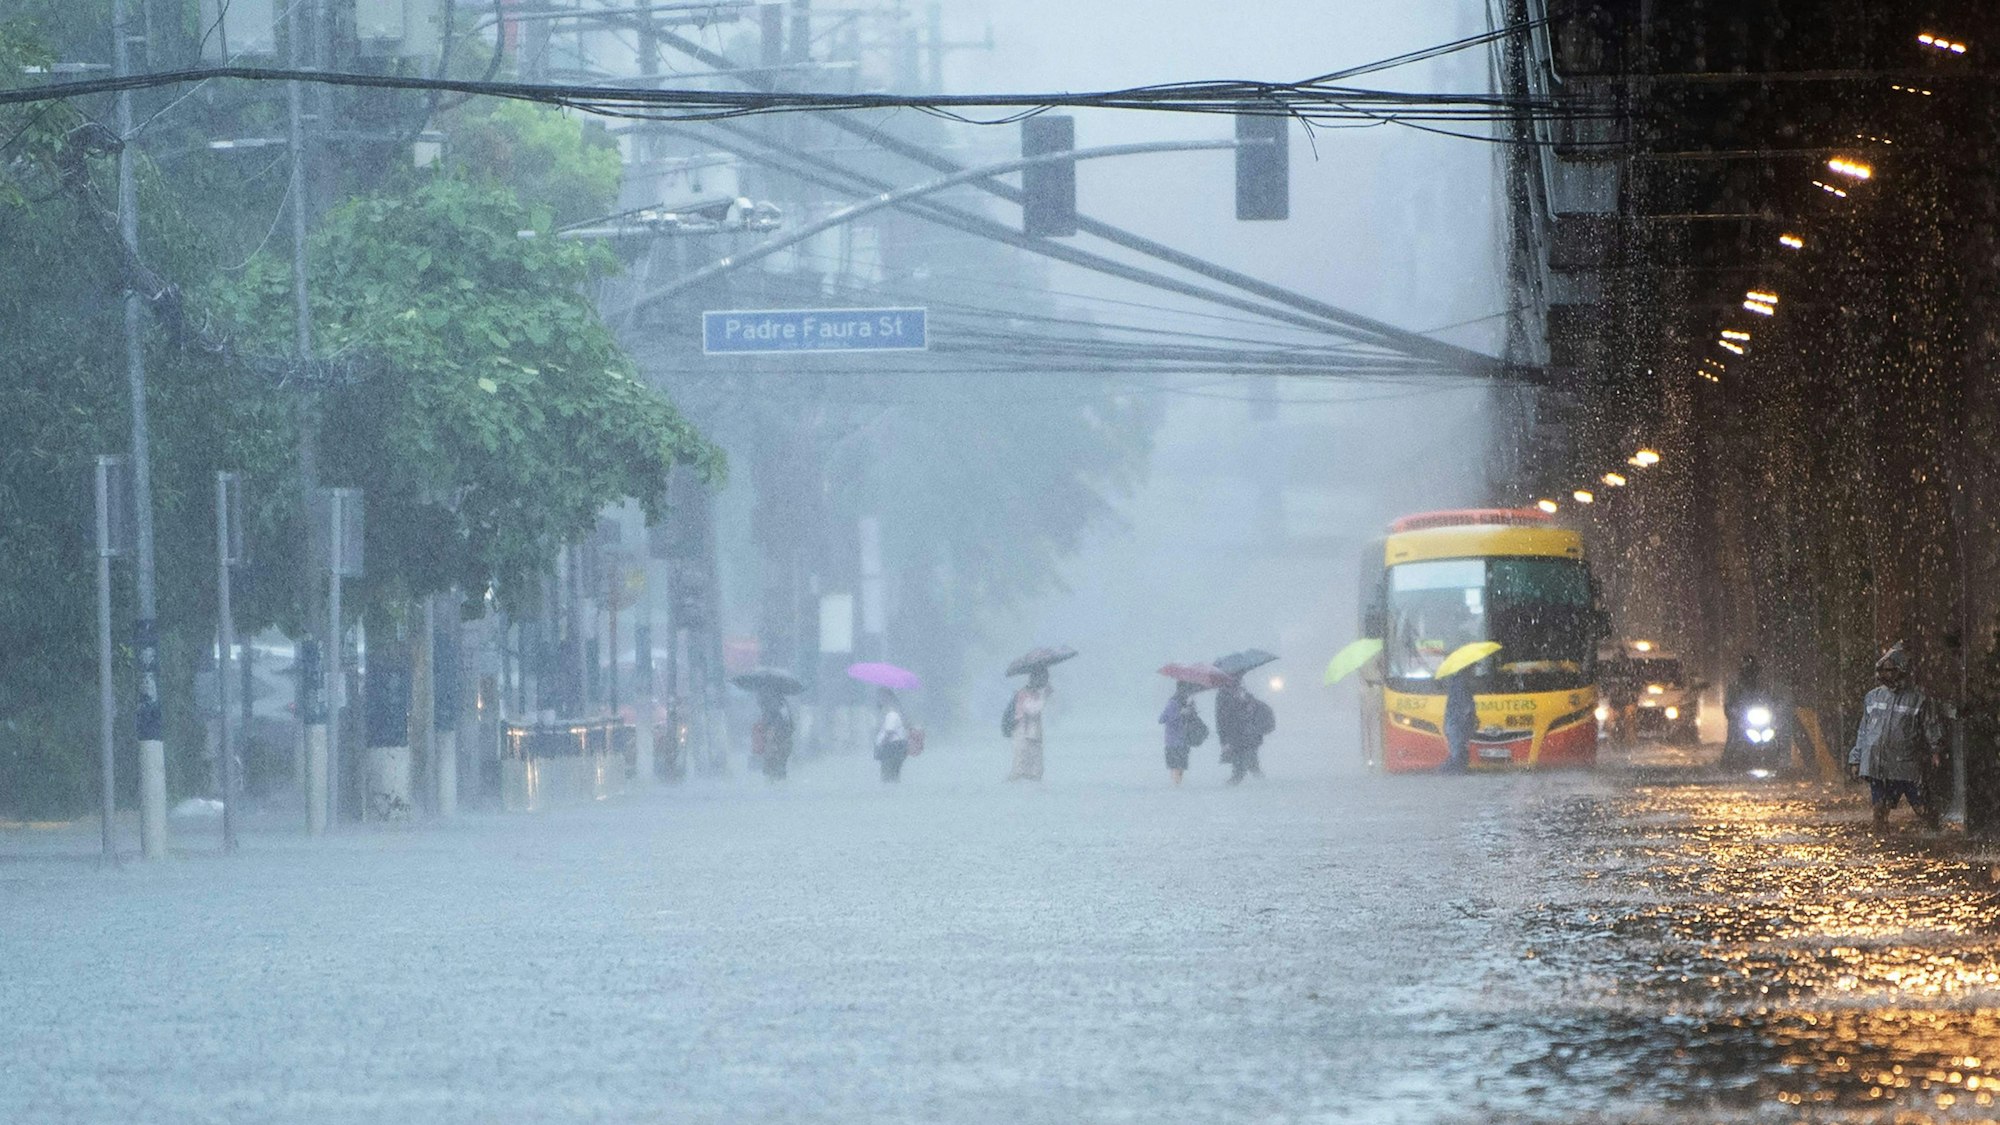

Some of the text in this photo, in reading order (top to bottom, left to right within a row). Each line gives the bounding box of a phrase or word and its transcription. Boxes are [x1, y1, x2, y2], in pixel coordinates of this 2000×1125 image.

[725, 315, 904, 340] Padre Faura St
[1474, 698, 1538, 711] MUTERS
